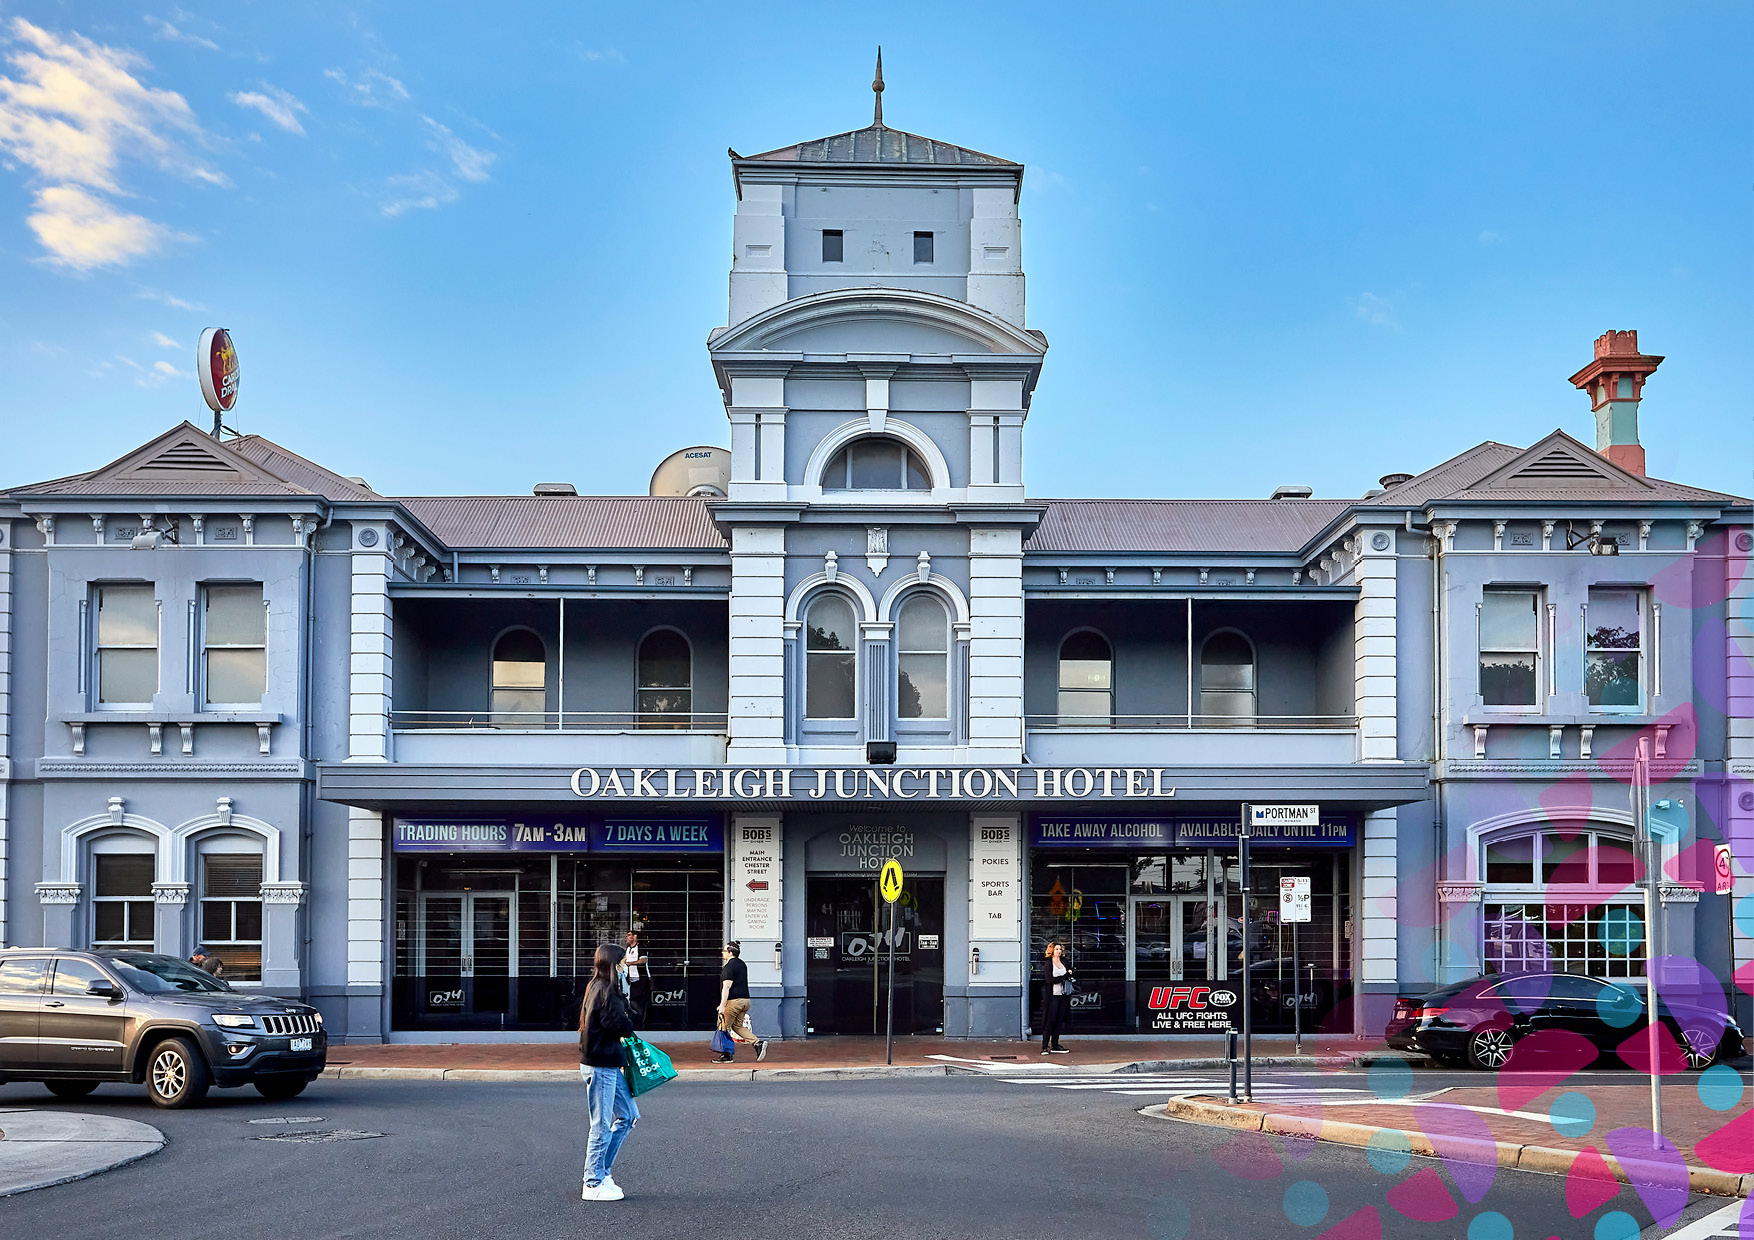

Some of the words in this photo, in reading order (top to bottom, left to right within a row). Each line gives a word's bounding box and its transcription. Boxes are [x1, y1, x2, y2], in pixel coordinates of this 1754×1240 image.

[570, 767, 794, 798] OAKLEIGH
[808, 767, 1022, 798] JUNCTION
[1033, 767, 1177, 798] HOTEL
[1265, 807, 1309, 819] PORTMAN
[398, 825, 458, 841] TRADING
[461, 825, 507, 841] HOURS
[605, 825, 613, 841] 7
[617, 825, 652, 841] DAYS
[656, 825, 667, 841] A
[669, 825, 709, 841] WEEK
[849, 824, 893, 833] Welcome
[896, 824, 906, 833] to
[1041, 823, 1071, 838] TAKE
[1073, 823, 1107, 838] AWAY
[1110, 823, 1163, 838] ALCOHOL
[1179, 823, 1241, 838] AVAILABLE
[1283, 825, 1317, 837] UNTIL
[1320, 823, 1347, 837] 11PM
[742, 829, 772, 840] BOBS
[839, 833, 914, 844] OAKLEIGH
[981, 829, 1010, 840] BOBS
[840, 845, 914, 857] JUNCTION
[859, 857, 888, 869] HOT
[987, 889, 1003, 897] BAR
[1147, 986, 1211, 1010] UFC
[1214, 993, 1231, 1001] FOX
[1156, 1012, 1174, 1020] ALL
[1175, 1012, 1194, 1020] UFC
[1196, 1012, 1228, 1020] FIGHTS
[1152, 1021, 1172, 1029] LIVE
[1173, 1021, 1181, 1029] &
[1182, 1021, 1206, 1029] FREE
[1207, 1021, 1232, 1029] HERE
